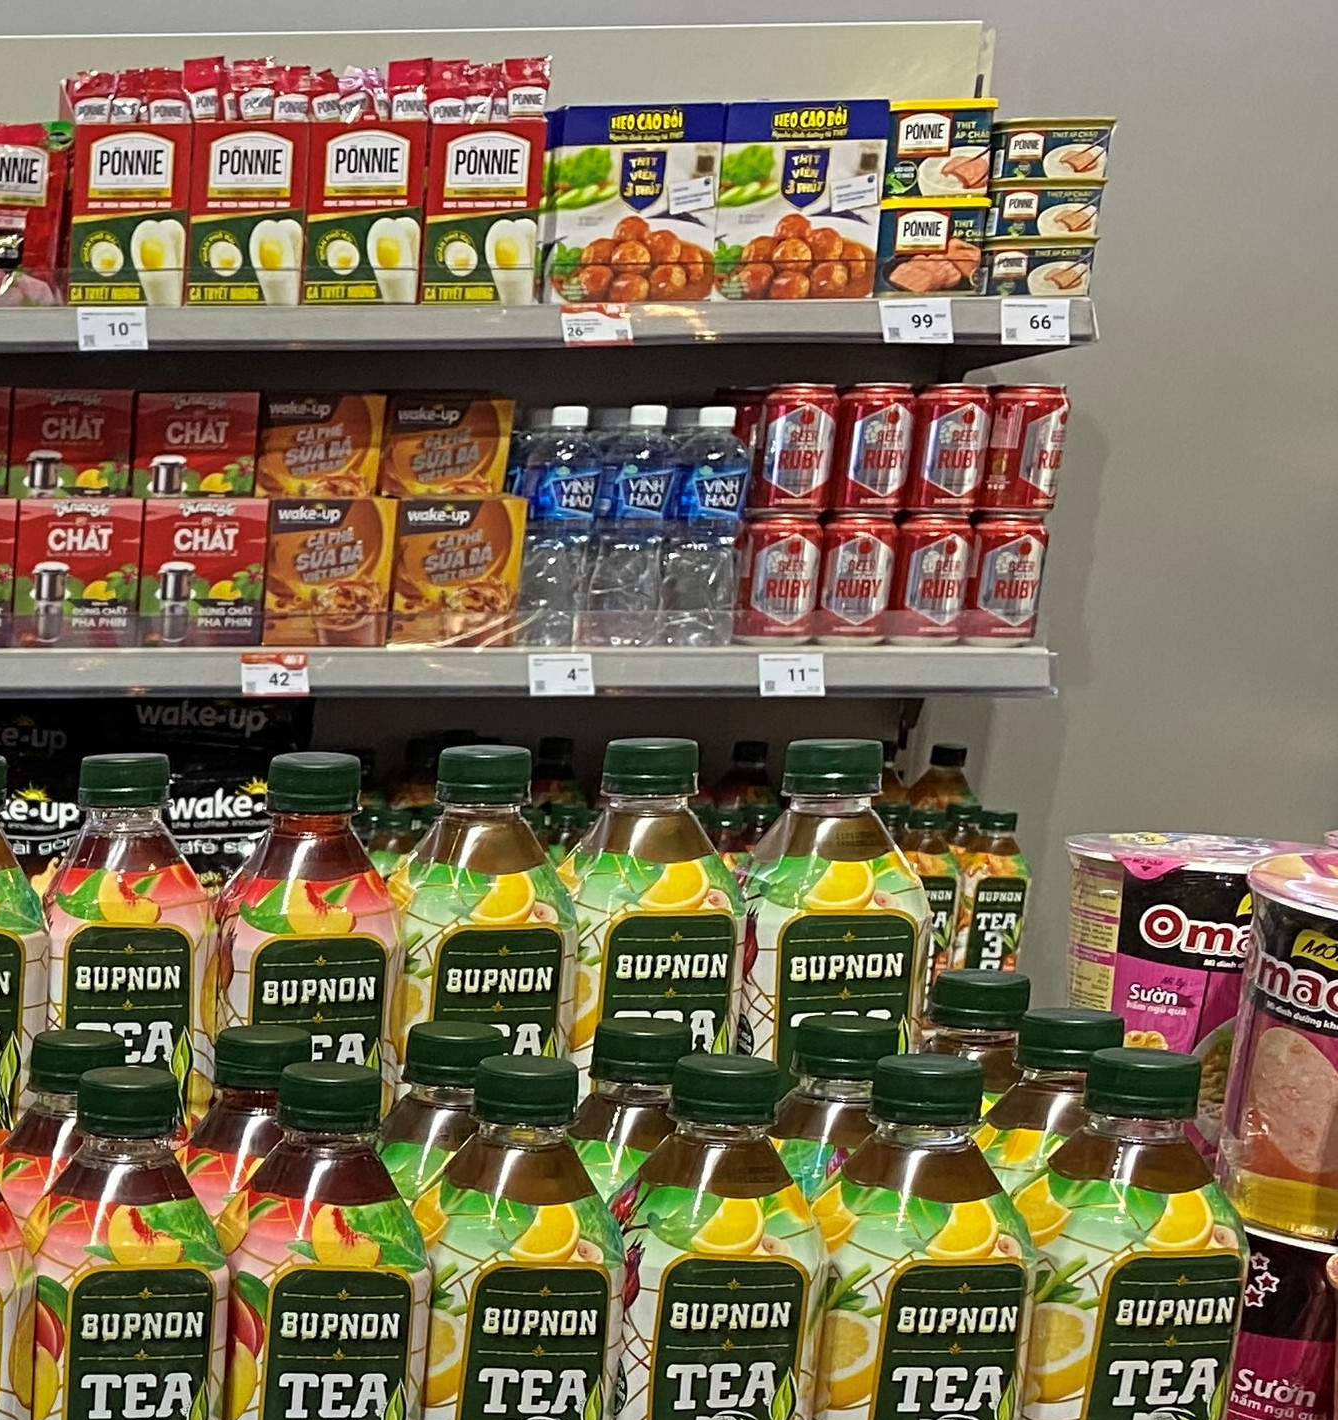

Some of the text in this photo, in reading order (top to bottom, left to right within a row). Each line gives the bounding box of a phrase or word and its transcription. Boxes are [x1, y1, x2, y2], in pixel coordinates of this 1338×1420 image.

[637, 112, 662, 130] CAO
[108, 322, 128, 336] 10
[911, 314, 933, 329] 99
[1029, 314, 1051, 329] 66
[766, 581, 809, 598] RUBY
[995, 580, 1038, 598] RUBY
[269, 672, 290, 686] 42
[568, 668, 576, 680] 4
[788, 668, 805, 681] 11
[979, 891, 1023, 902] BUPNON
[977, 913, 1016, 931] TEA
[790, 953, 903, 980] BUPNON
[74, 966, 181, 991] BUPNON
[262, 977, 377, 1004] BUPNON
[1129, 985, 1178, 1006] Sườn
[670, 1303, 791, 1329] BUPNON
[1115, 1297, 1235, 1325] BUPNON
[81, 1312, 204, 1340] BUPNON
[482, 1308, 598, 1336] BUPNON
[478, 1368, 586, 1413] TEA
[667, 1364, 776, 1408] TEA
[1235, 1369, 1316, 1407] Sườn
